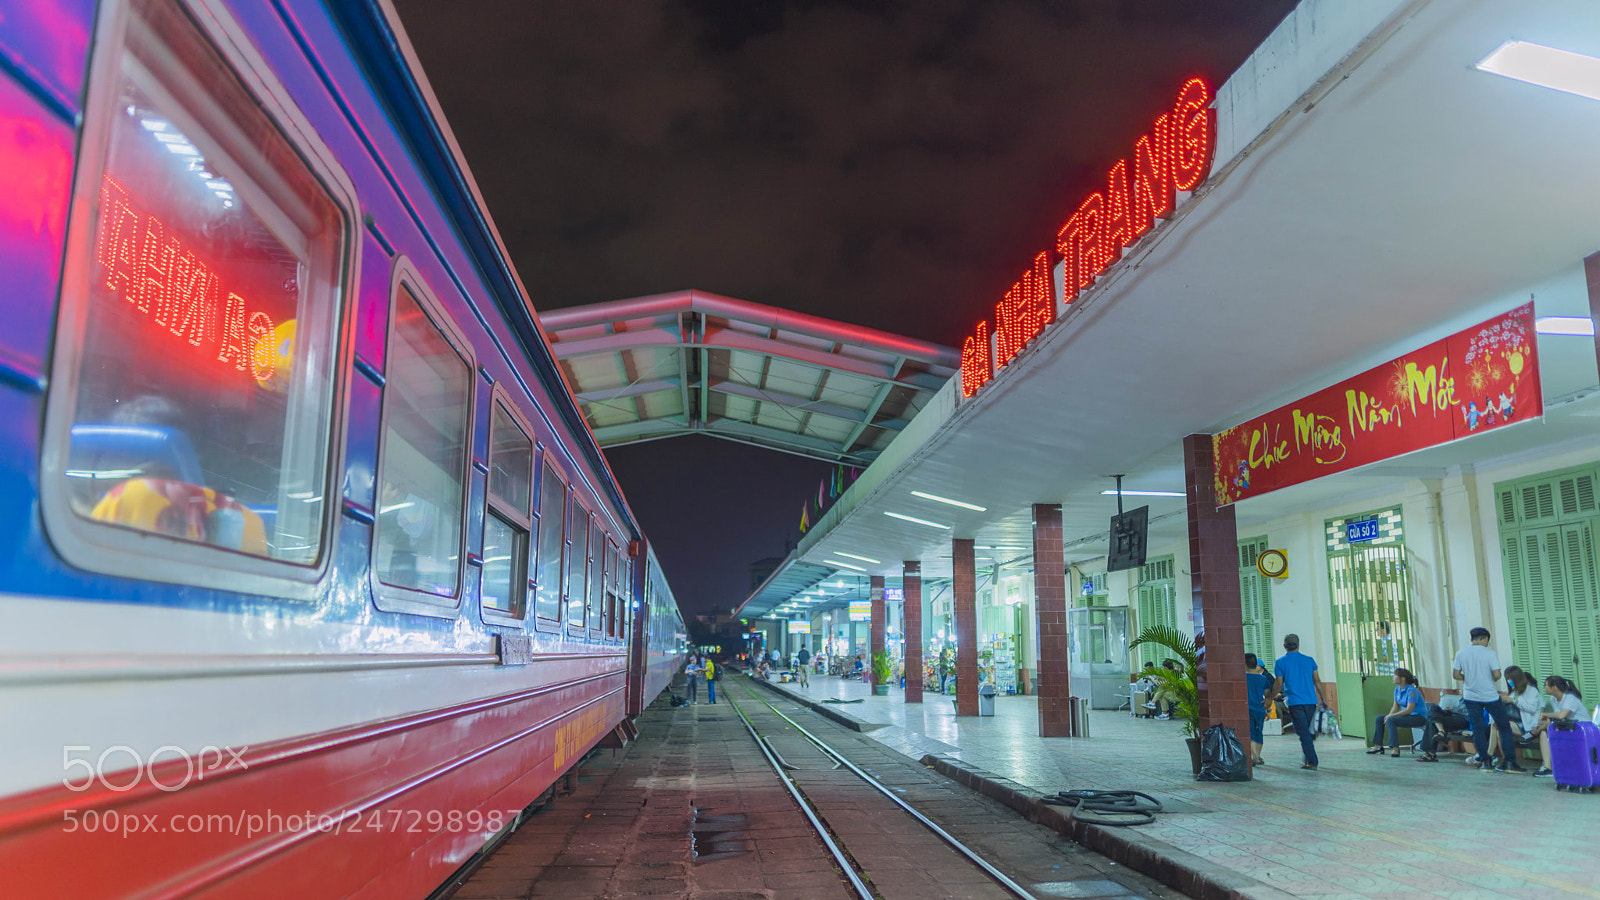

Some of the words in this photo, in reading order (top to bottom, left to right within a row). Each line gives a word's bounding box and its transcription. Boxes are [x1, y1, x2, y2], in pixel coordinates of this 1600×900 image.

[961, 320, 990, 398] GA
[996, 250, 1053, 370] NHA
[1057, 77, 1212, 304] TRANG
[1249, 421, 1291, 469] Chúc
[1292, 409, 1346, 465] Mừng
[1345, 389, 1402, 440] Năm
[1405, 357, 1461, 418] Mới
[1371, 524, 1376, 536] 2
